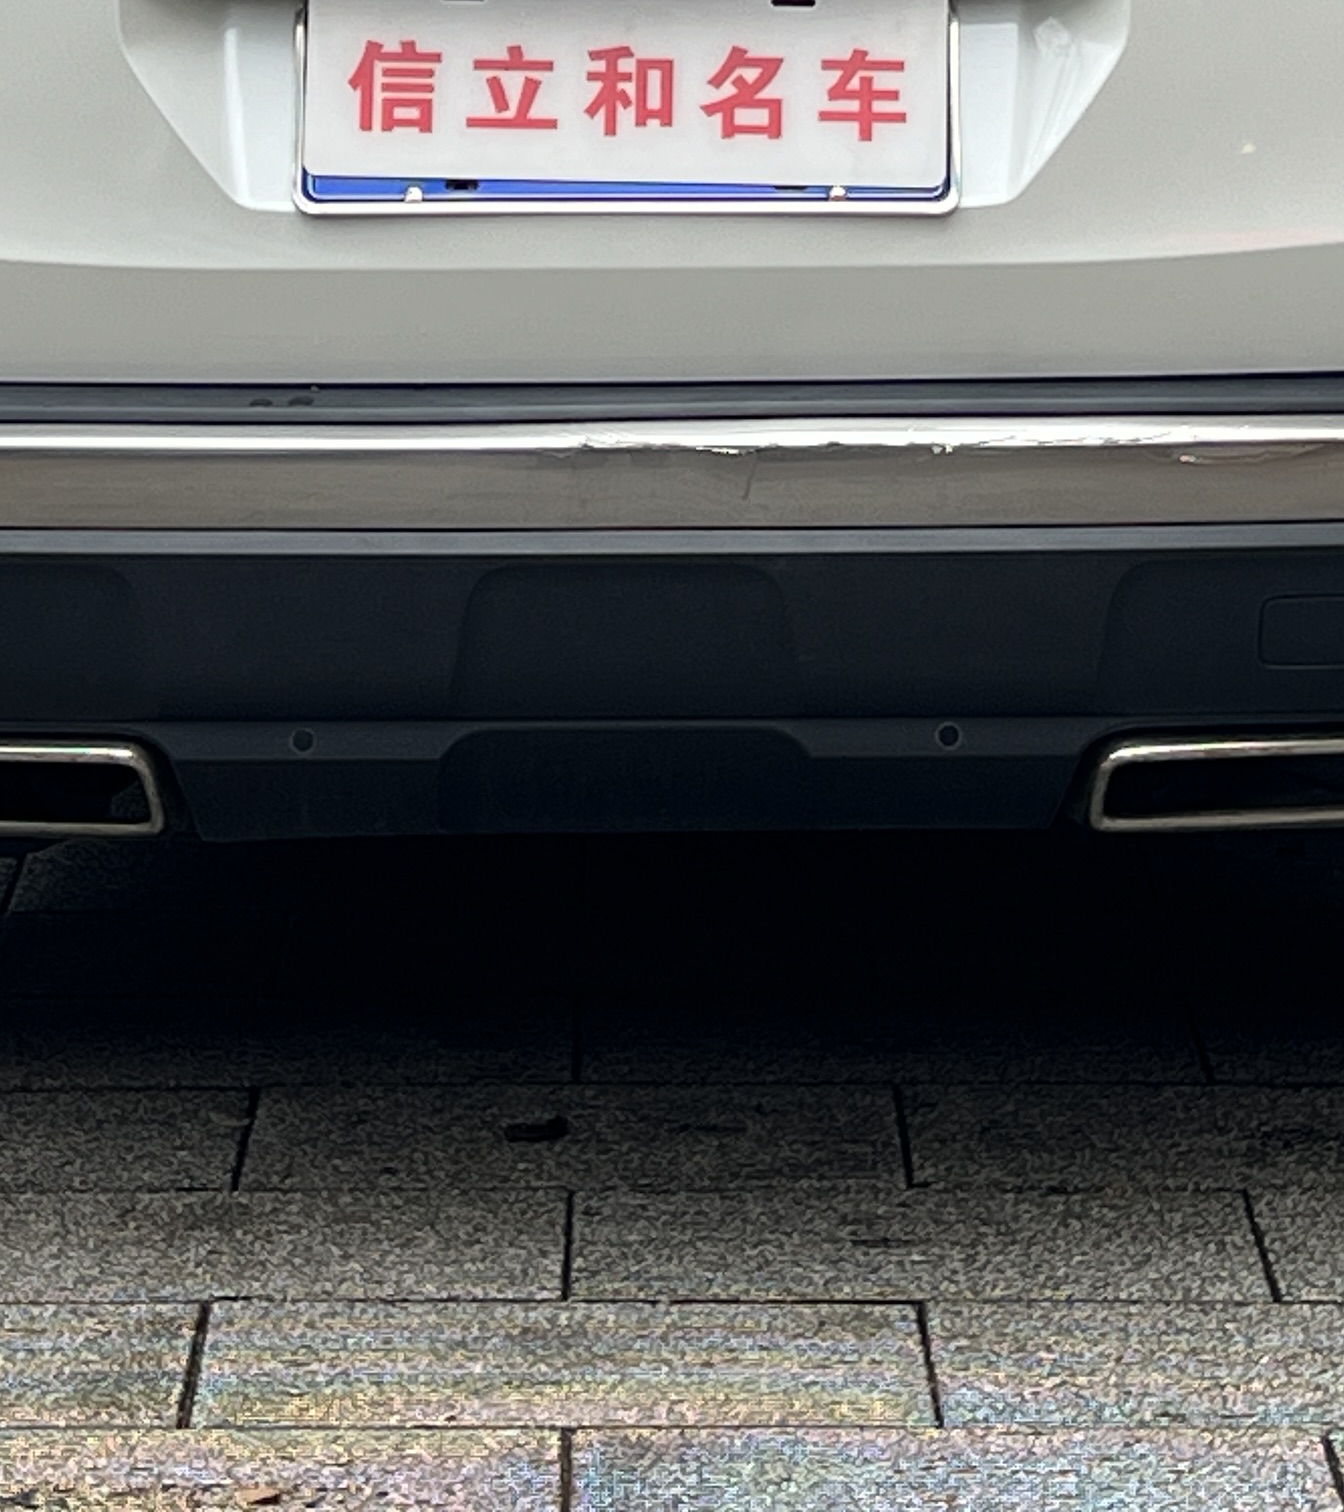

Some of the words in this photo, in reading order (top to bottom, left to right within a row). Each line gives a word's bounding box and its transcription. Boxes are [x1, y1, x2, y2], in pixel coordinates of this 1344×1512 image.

[347, 39, 908, 142] 信立和名车
